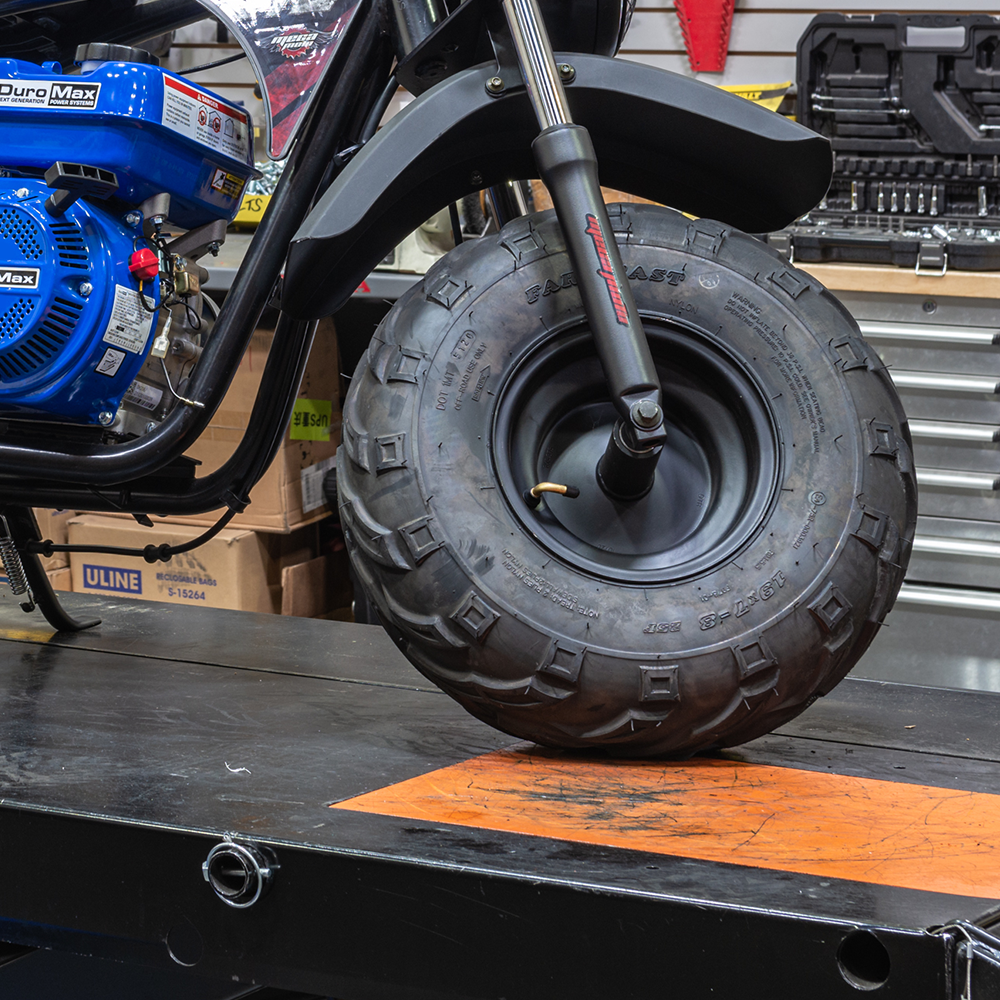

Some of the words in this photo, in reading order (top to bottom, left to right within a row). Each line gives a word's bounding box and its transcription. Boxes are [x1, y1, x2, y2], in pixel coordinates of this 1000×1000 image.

[201, 96, 219, 108] DANGER
[525, 271, 579, 304] FAR
[624, 265, 686, 286] AST
[730, 290, 762, 314] WARNING
[722, 304, 754, 326] OPERATING
[464, 359, 477, 373] USE
[471, 341, 488, 360] ONLY
[736, 303, 749, 314] NOT
[748, 312, 770, 331] INFLATE
[768, 330, 788, 351] BEYOND
[809, 391, 821, 415] SEATING
[434, 389, 449, 411] DOT
[86, 568, 139, 590] ULINE
[156, 572, 197, 585] RECLOSABLE
[198, 577, 217, 587] BAGS
[168, 587, 206, 600] S-15264
